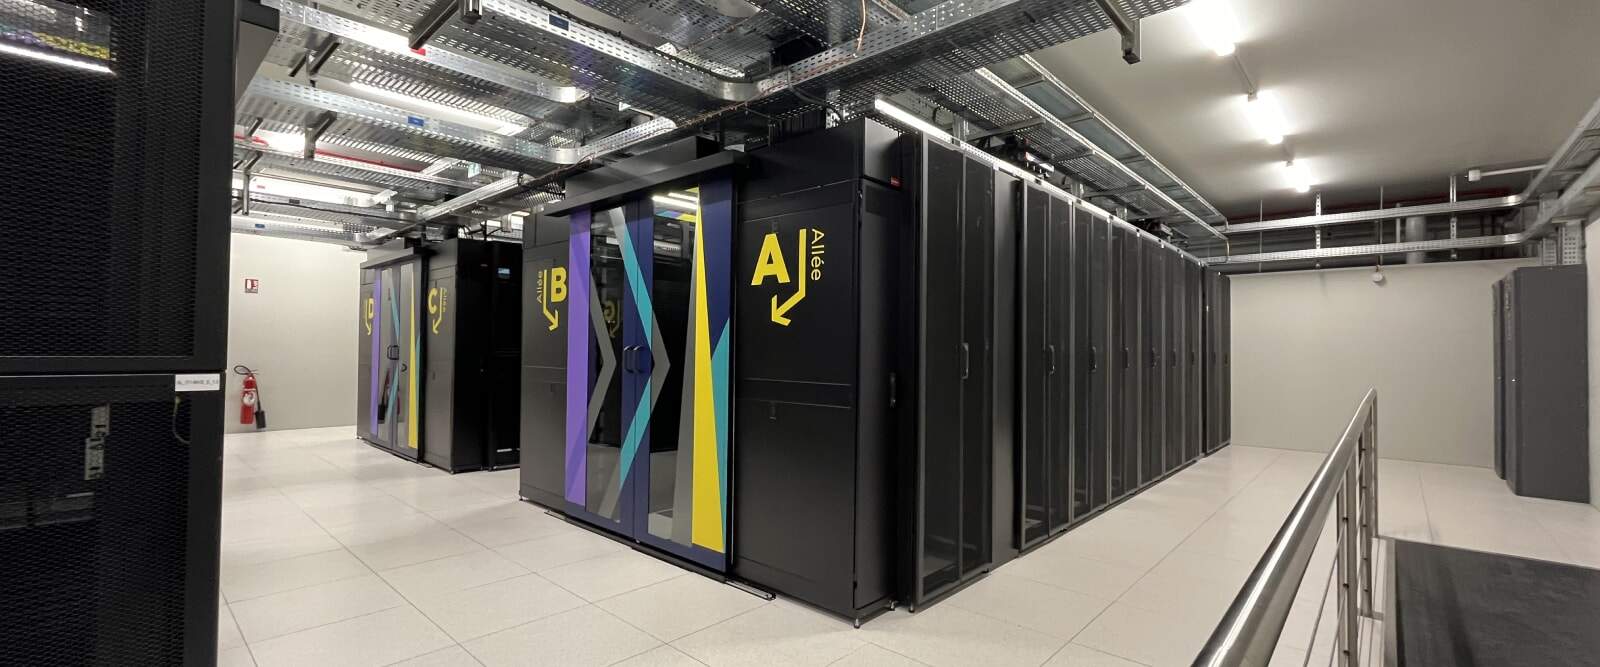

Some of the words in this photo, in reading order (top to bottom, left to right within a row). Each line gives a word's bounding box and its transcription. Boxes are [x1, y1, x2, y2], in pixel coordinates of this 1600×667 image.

[751, 233, 791, 286] A
[810, 228, 825, 281] Allée
[428, 287, 438, 314] C
[551, 267, 567, 303] B
